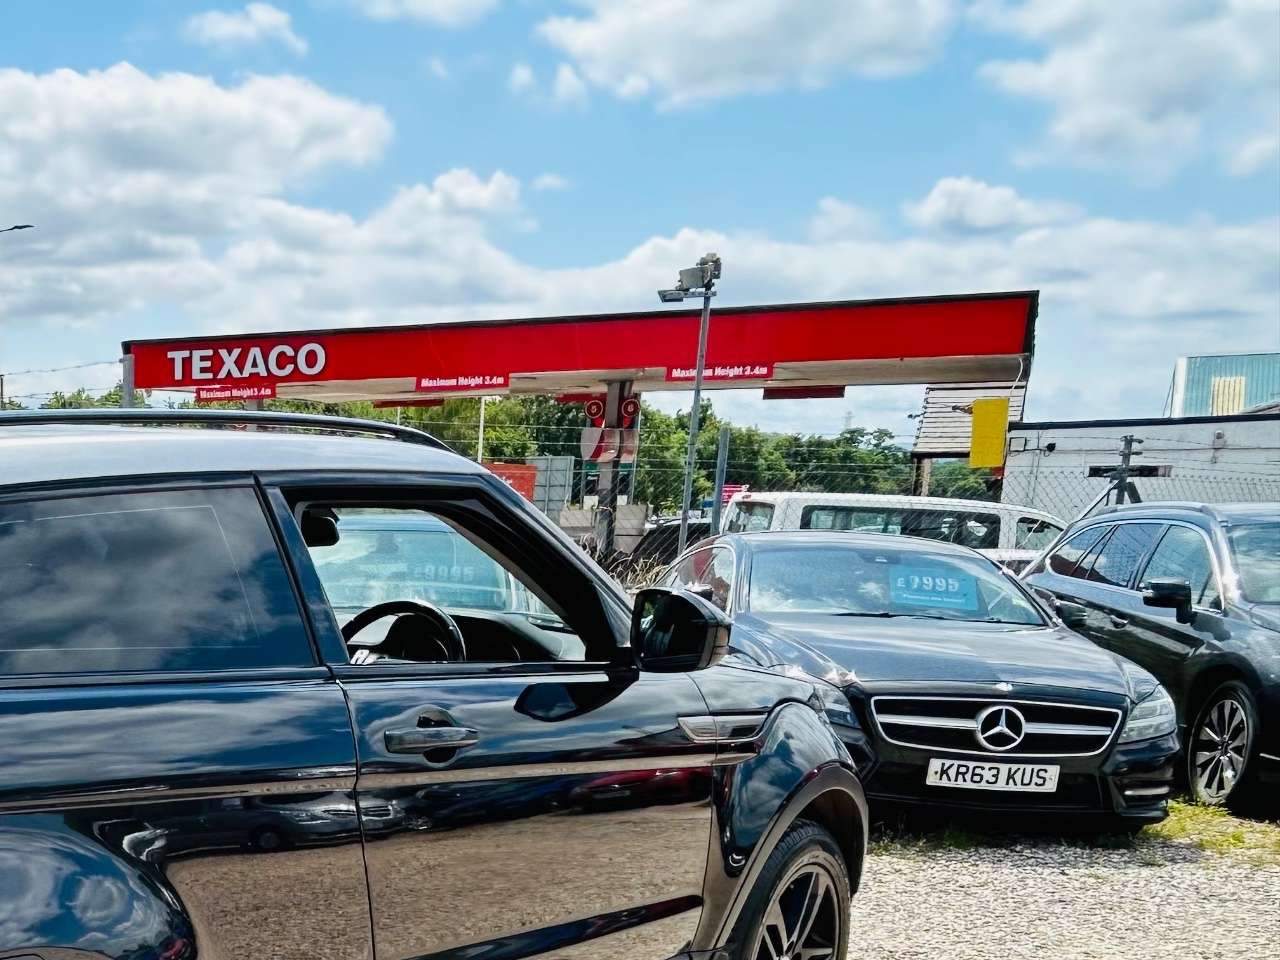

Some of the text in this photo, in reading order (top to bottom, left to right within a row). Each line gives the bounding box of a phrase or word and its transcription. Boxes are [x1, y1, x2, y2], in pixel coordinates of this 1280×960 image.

[166, 342, 326, 381] TEXACO
[939, 762, 1048, 786] KR63 KUS
